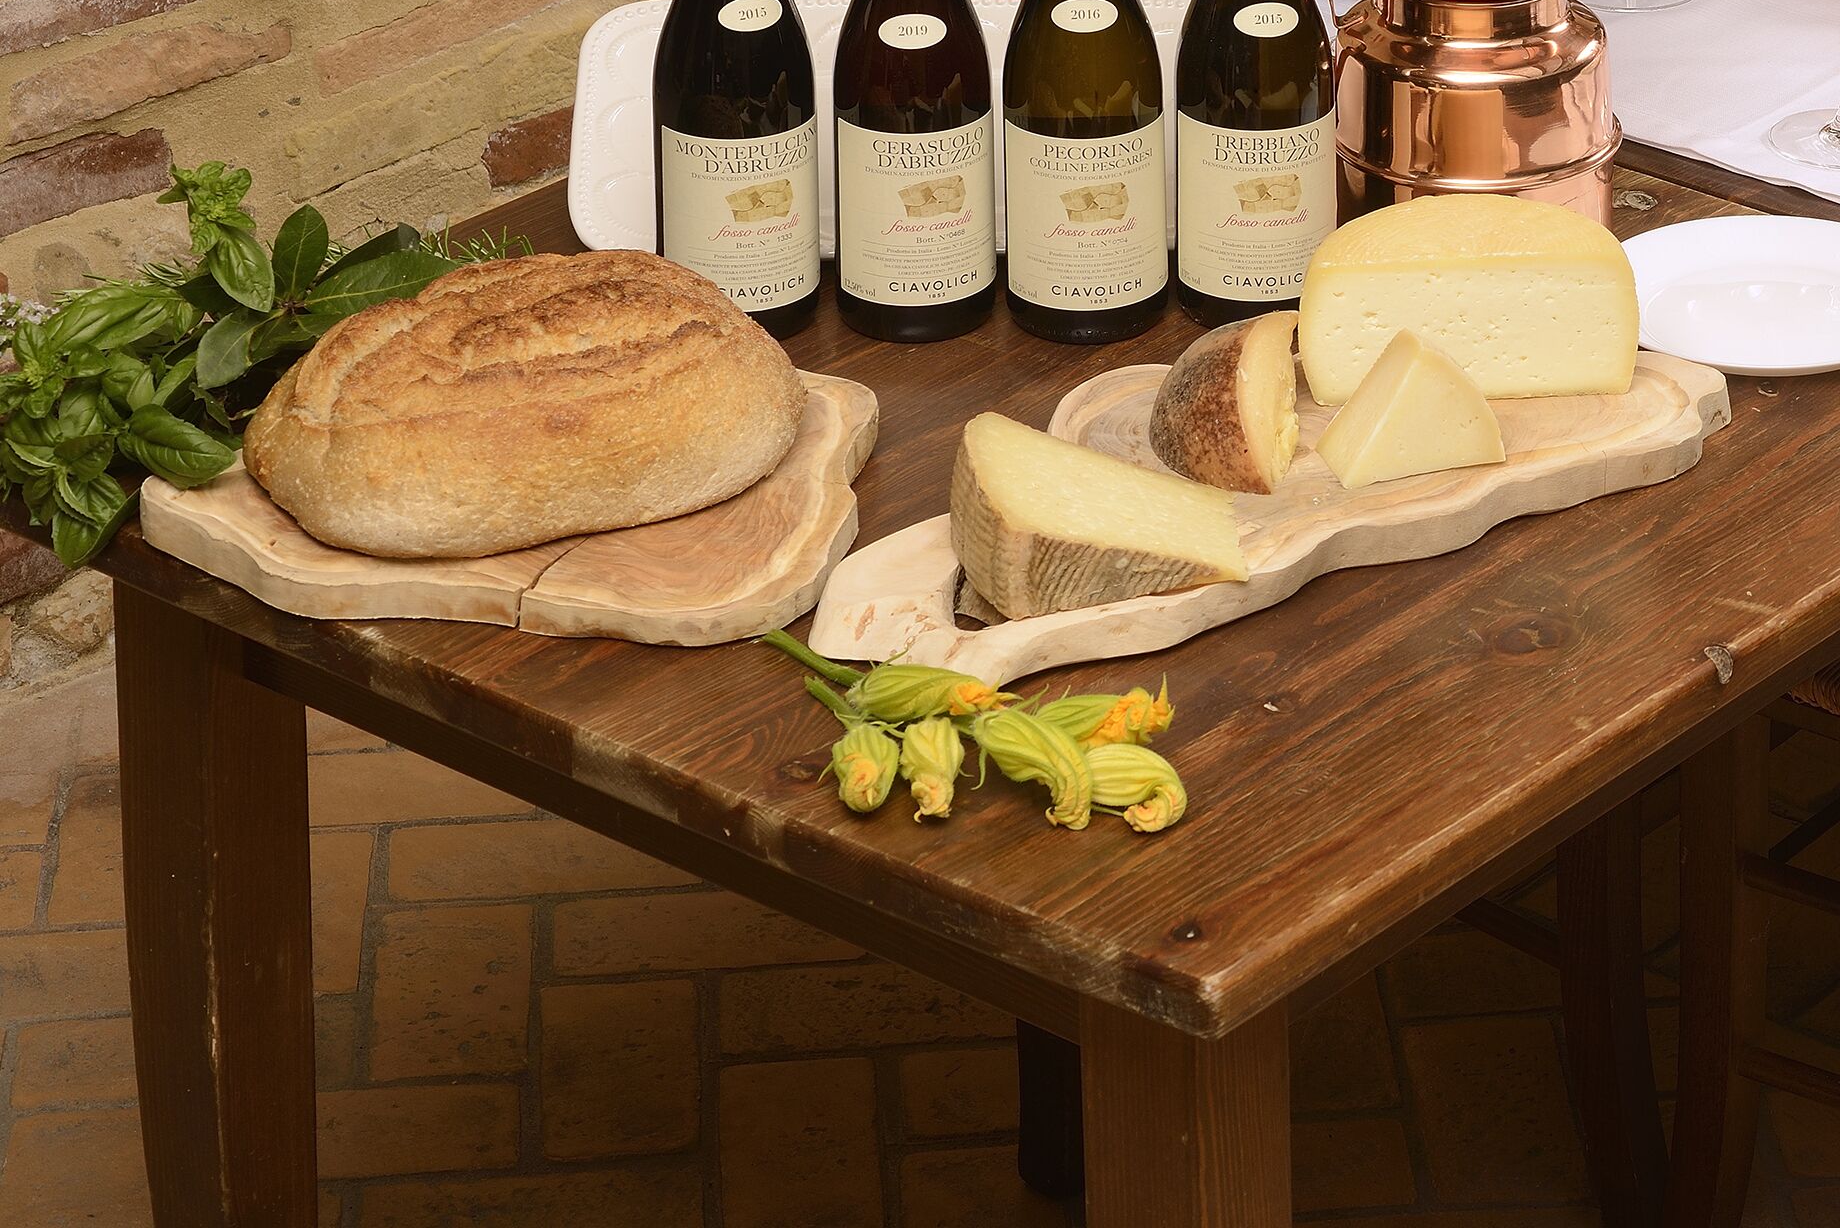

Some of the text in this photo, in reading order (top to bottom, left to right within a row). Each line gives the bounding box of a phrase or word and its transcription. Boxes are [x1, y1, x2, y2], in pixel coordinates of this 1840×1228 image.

[738, 7, 767, 21] 2015
[1070, 8, 1101, 21] 2016
[1254, 12, 1283, 26] 2015
[897, 25, 928, 38] 2019
[675, 123, 816, 160] MONTEPULCIAN
[872, 126, 983, 155] CERASUOLO
[1044, 138, 1143, 160] PECORINO
[1212, 128, 1320, 152] TREBBIANO
[705, 145, 808, 174] D'ABRUZZO
[878, 142, 981, 169] D'ABRUZZO
[1030, 148, 1152, 172] COLLINE PESCARESI
[1215, 142, 1318, 164] D'ABRUZZO
[708, 213, 801, 241] fosso cancelli
[881, 209, 972, 235] fosso cancelli
[1044, 216, 1137, 238] fosso cancelli
[1216, 208, 1308, 228] fosso cancelli
[888, 270, 978, 292] CIAVOLICH
[1052, 278, 1142, 297] CIAVOLICH
[1223, 272, 1303, 287] CIAVOLIC
